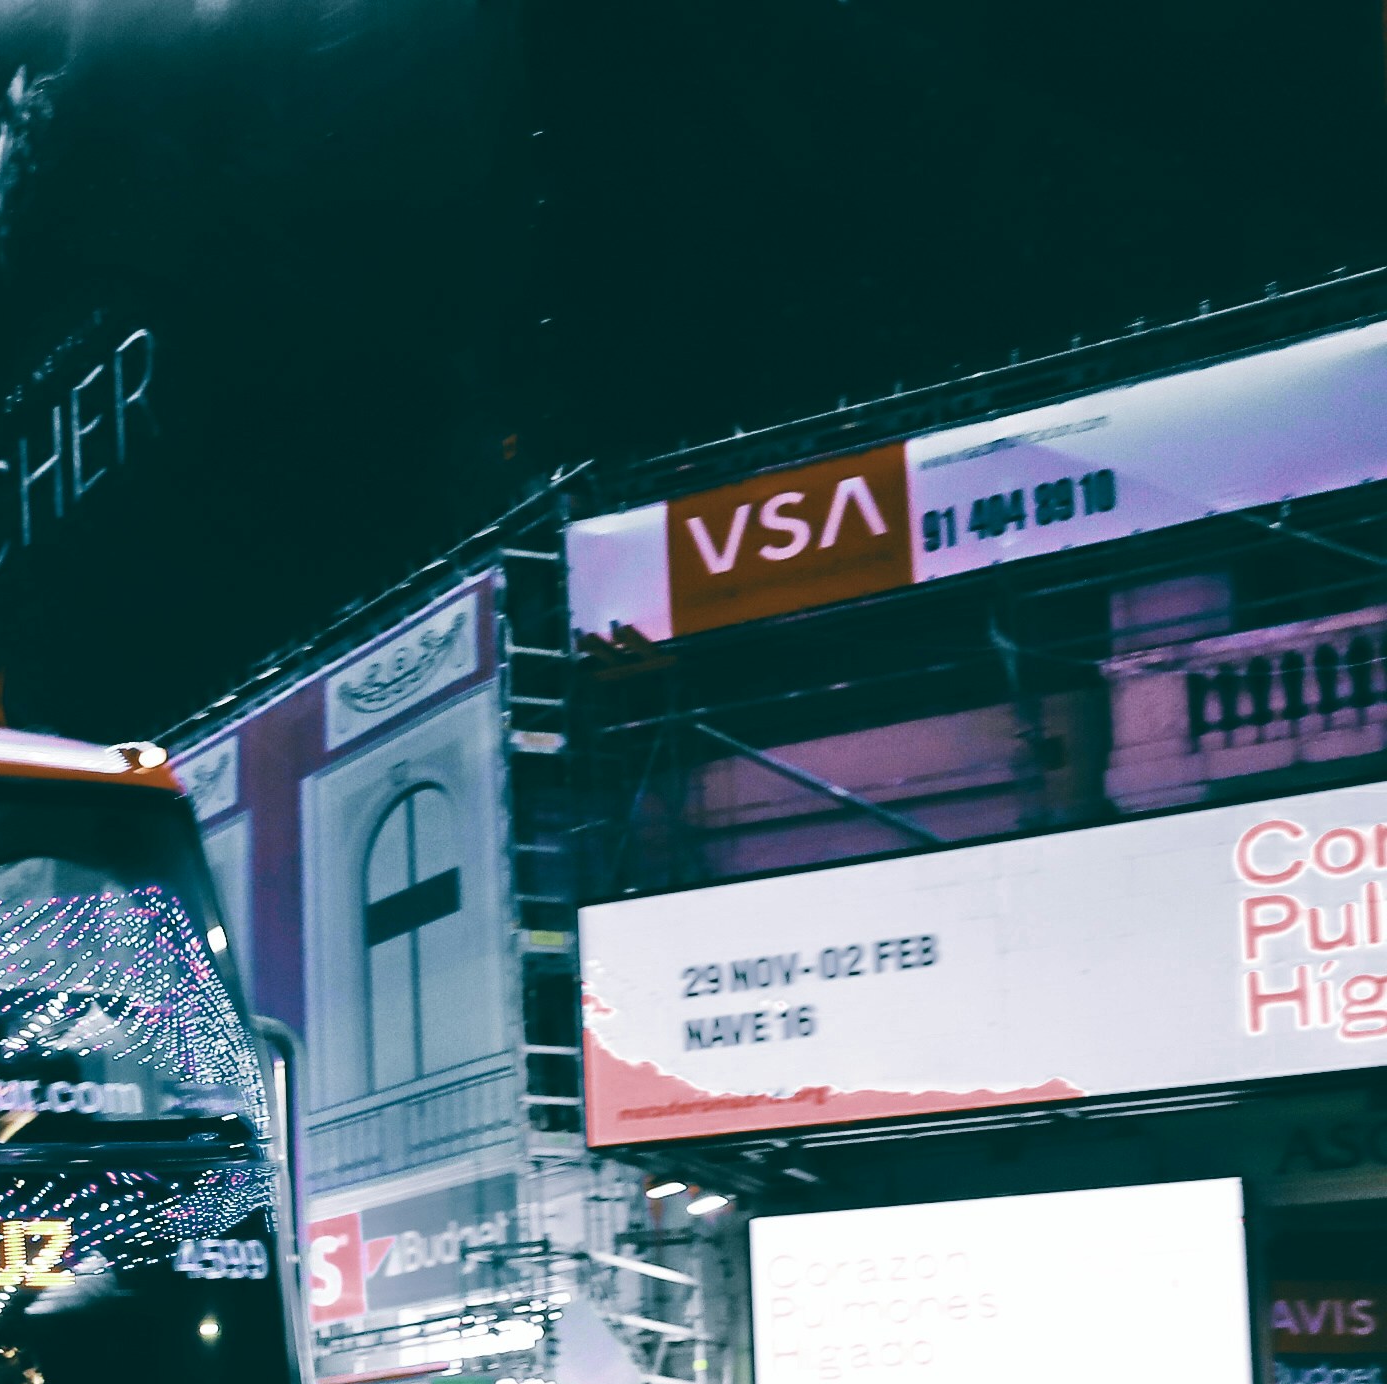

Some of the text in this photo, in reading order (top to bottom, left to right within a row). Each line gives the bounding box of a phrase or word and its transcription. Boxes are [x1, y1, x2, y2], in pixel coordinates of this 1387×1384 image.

[685, 475, 888, 575] VSA
[923, 506, 957, 552] 91
[1079, 468, 1116, 515] 10
[681, 963, 723, 998] 29
[873, 933, 937, 973] FEB
[684, 1003, 816, 1052] NAVE 16
[172, 1238, 269, 1280] 4599
[1270, 1299, 1376, 1336] AVIS
